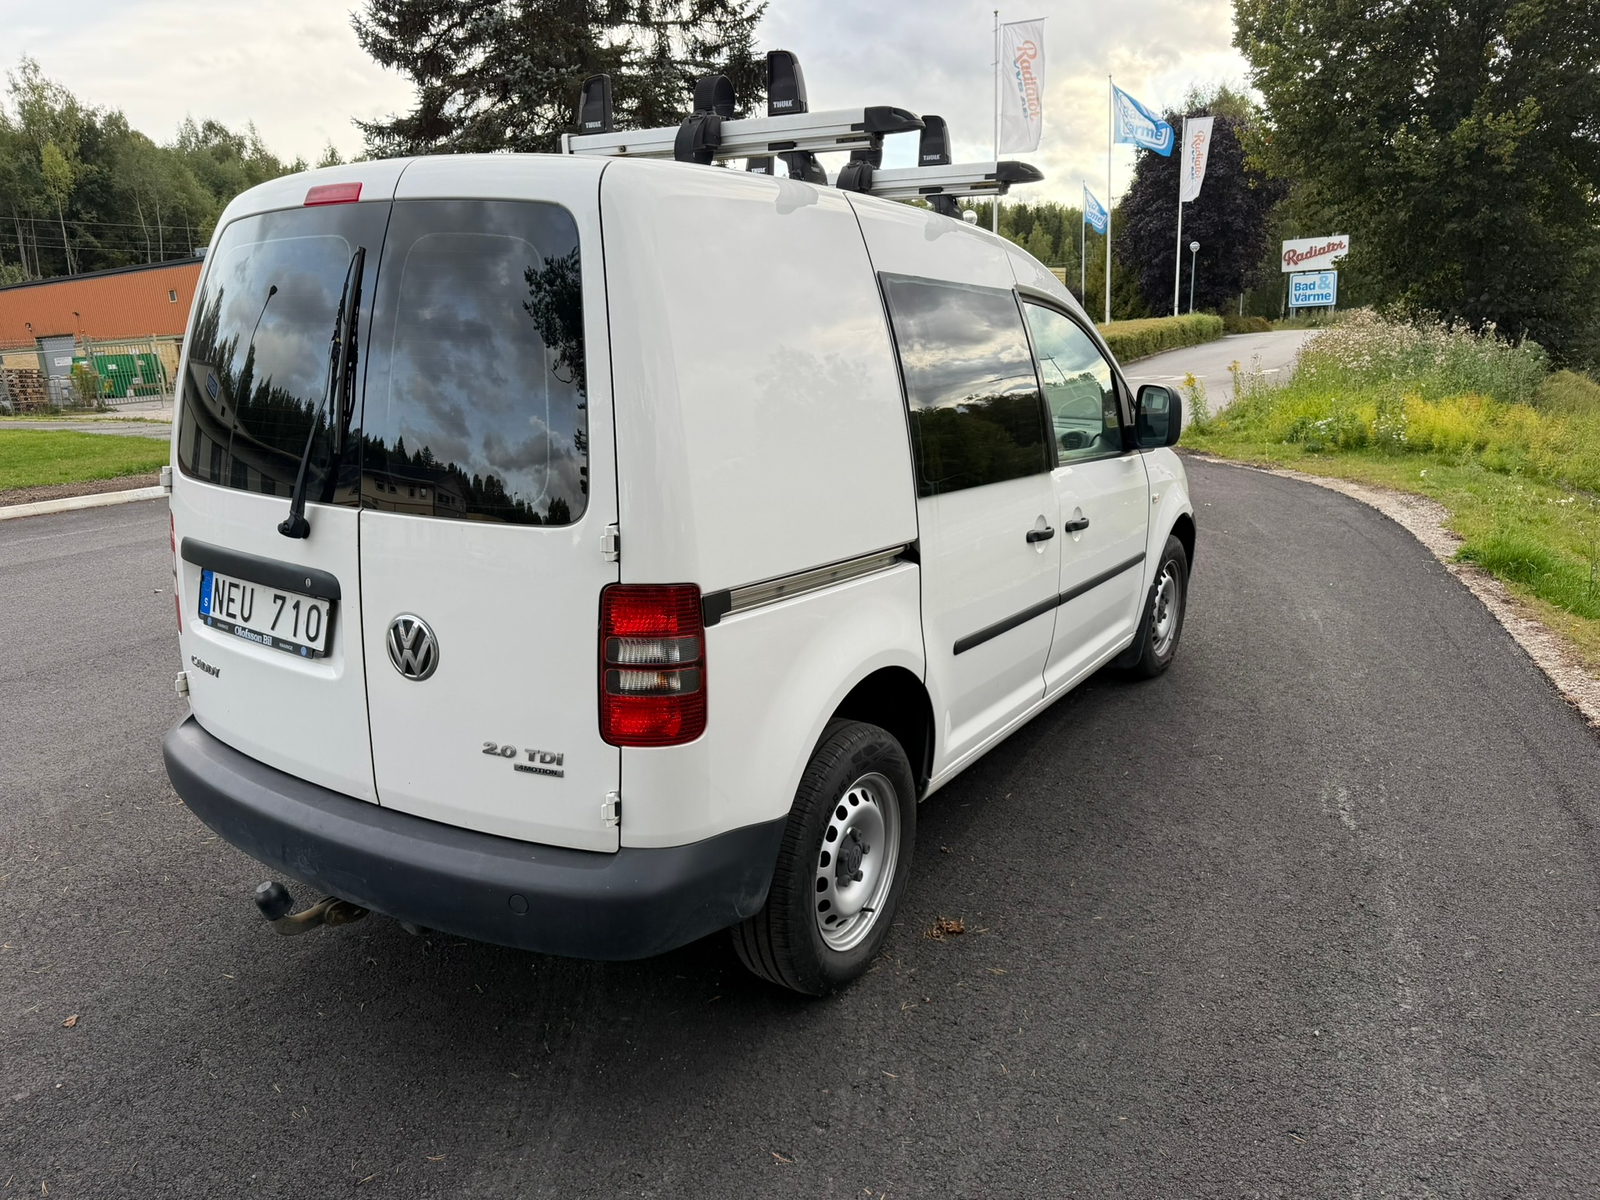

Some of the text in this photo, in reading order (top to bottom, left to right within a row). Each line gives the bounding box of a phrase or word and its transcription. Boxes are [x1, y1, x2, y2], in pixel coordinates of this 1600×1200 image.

[1016, 39, 1040, 122] Radiator
[773, 99, 793, 108] THULE
[585, 121, 602, 129] THULE
[923, 153, 941, 161] THULE
[1283, 240, 1346, 266] Radiator
[1294, 275, 1331, 292] Bad &
[1294, 292, 1331, 302] Värme
[203, 597, 209, 607] S
[212, 577, 321, 643] NEU 710
[234, 625, 262, 644] Olofsson
[263, 635, 273, 647] Bil
[482, 741, 564, 766] 2.0 TDI
[518, 765, 558, 776] 4MOTION
